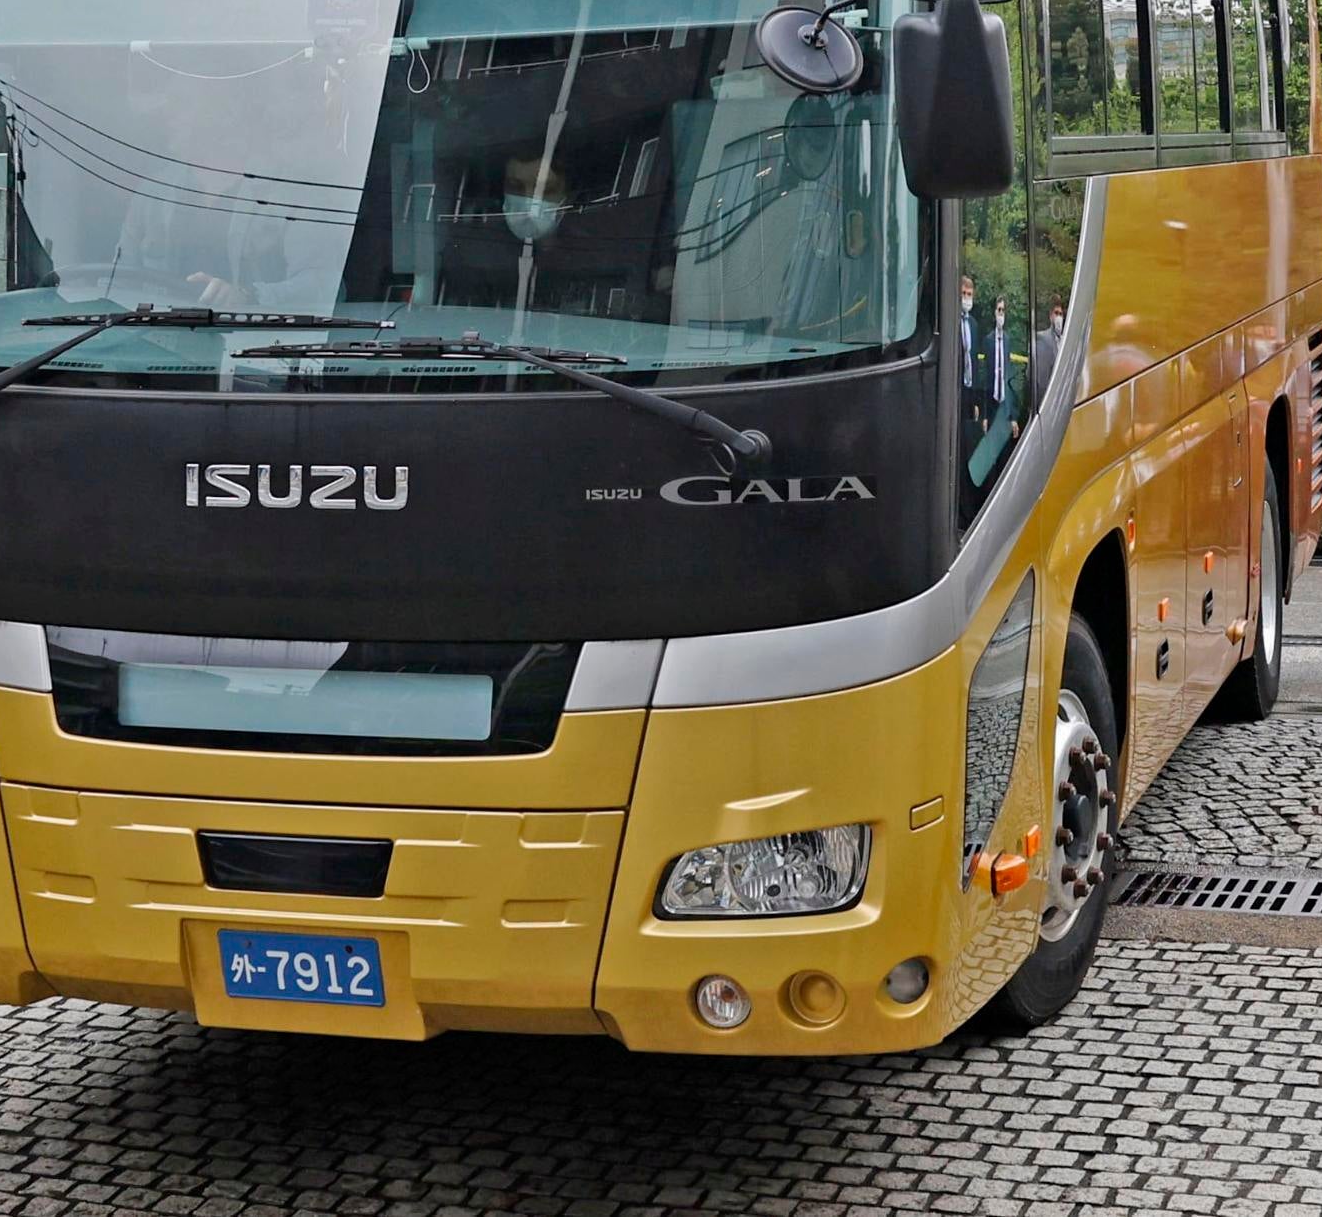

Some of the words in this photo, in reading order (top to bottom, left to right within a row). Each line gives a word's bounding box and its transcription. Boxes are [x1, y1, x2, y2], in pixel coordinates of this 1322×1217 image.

[185, 463, 409, 511] ISUZU
[585, 488, 643, 501] ISUZU
[659, 475, 876, 506] GALA
